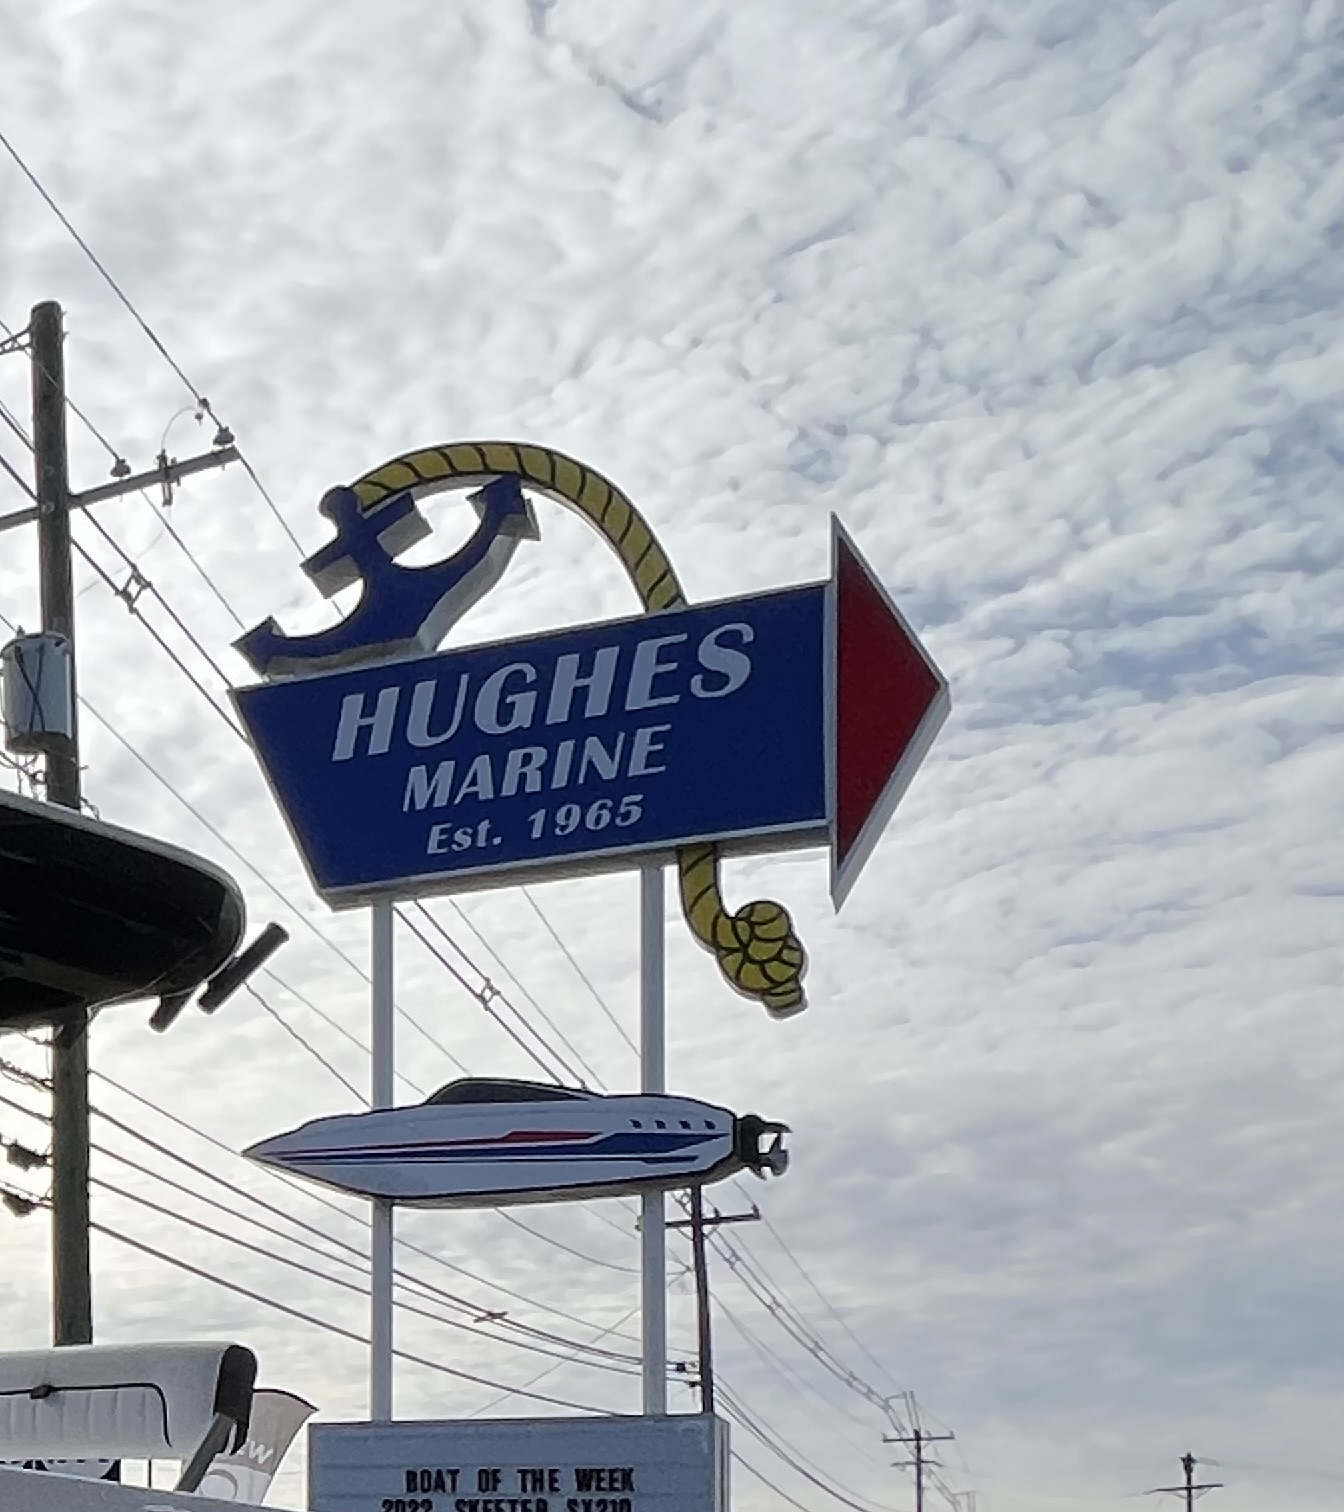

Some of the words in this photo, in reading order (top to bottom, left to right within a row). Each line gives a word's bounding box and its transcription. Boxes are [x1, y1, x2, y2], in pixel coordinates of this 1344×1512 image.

[332, 622, 755, 760] HUGHES
[403, 725, 670, 812] MARINE
[427, 823, 502, 854] Est.
[528, 795, 643, 840] 1965
[405, 1469, 460, 1493] BOAT
[478, 1469, 501, 1492] OF
[518, 1469, 560, 1492] THE
[575, 1467, 634, 1492] WEEK
